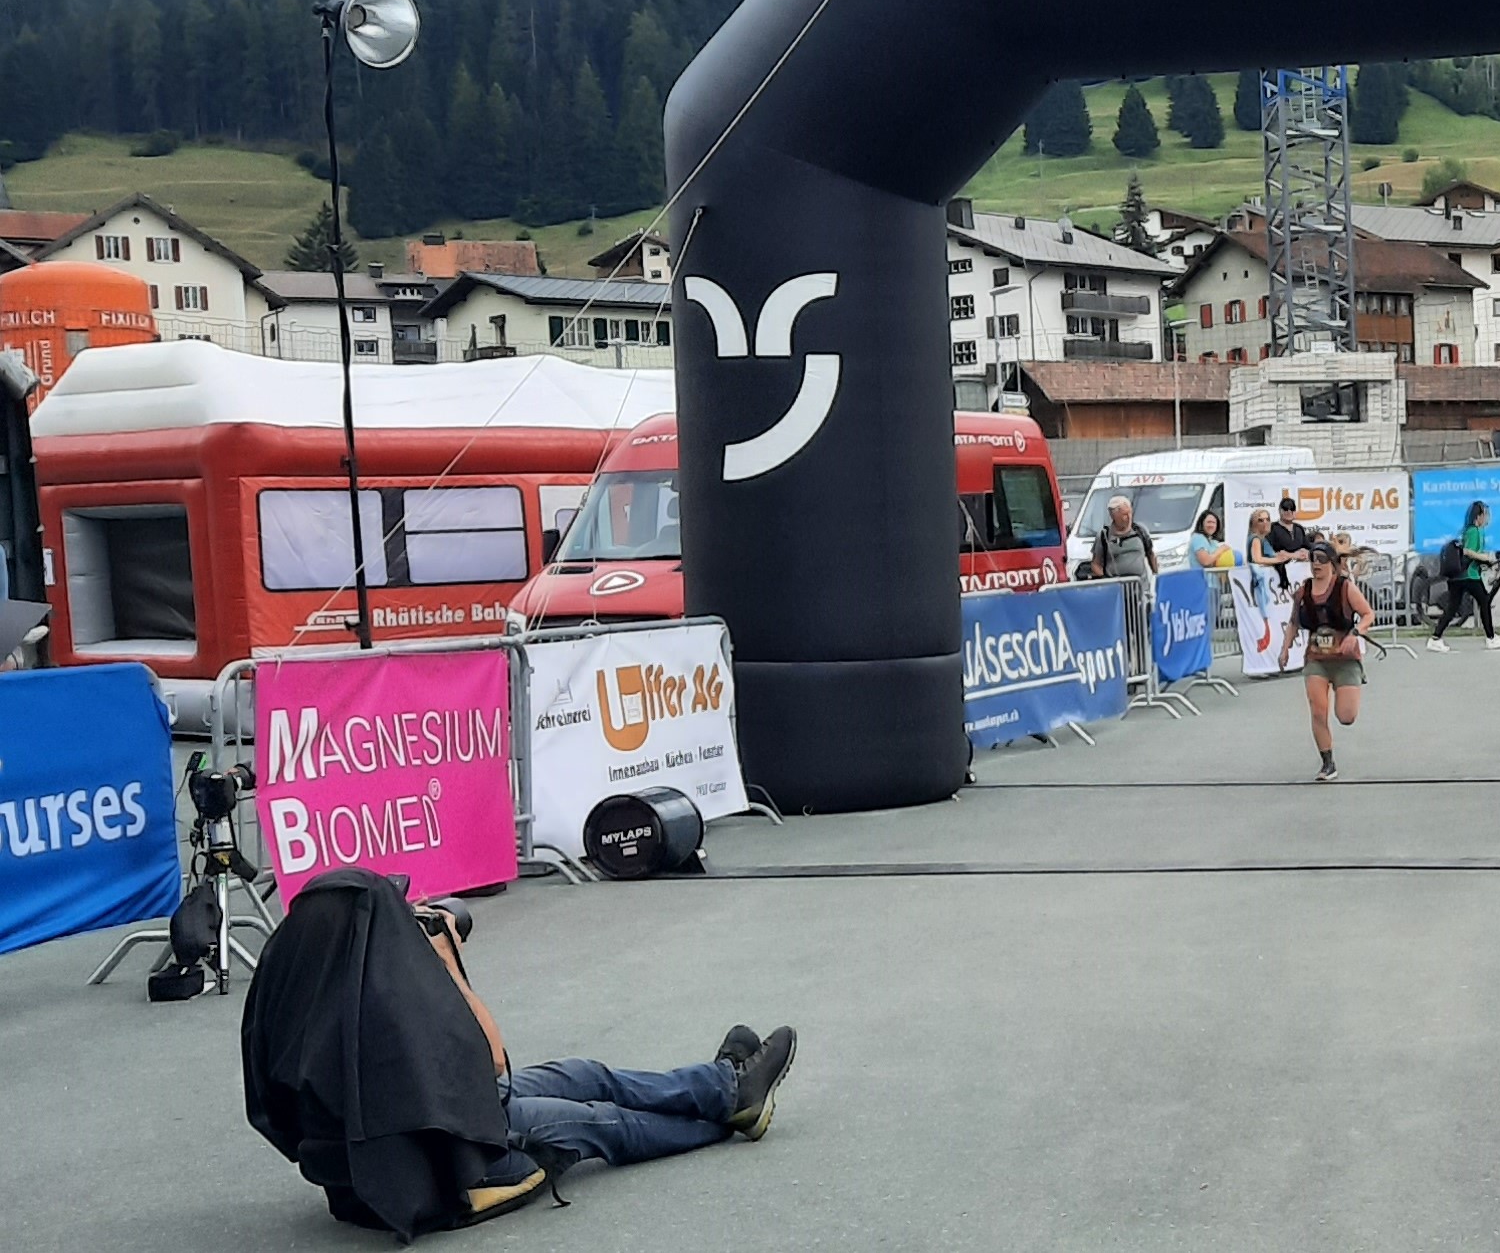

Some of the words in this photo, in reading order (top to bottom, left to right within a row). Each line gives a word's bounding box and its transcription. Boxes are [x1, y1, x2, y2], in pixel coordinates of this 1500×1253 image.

[1370, 487, 1399, 510] AG
[1423, 479, 1486, 493] Kantonale
[372, 603, 465, 628] Rhätische
[471, 601, 508, 622] Bah
[1076, 639, 1125, 695] sport
[596, 663, 687, 751] Uffer
[691, 662, 724, 714] AG
[267, 707, 502, 784] MAGNESIUM
[0, 781, 146, 857] urses
[601, 826, 652, 845] MYLAPS
